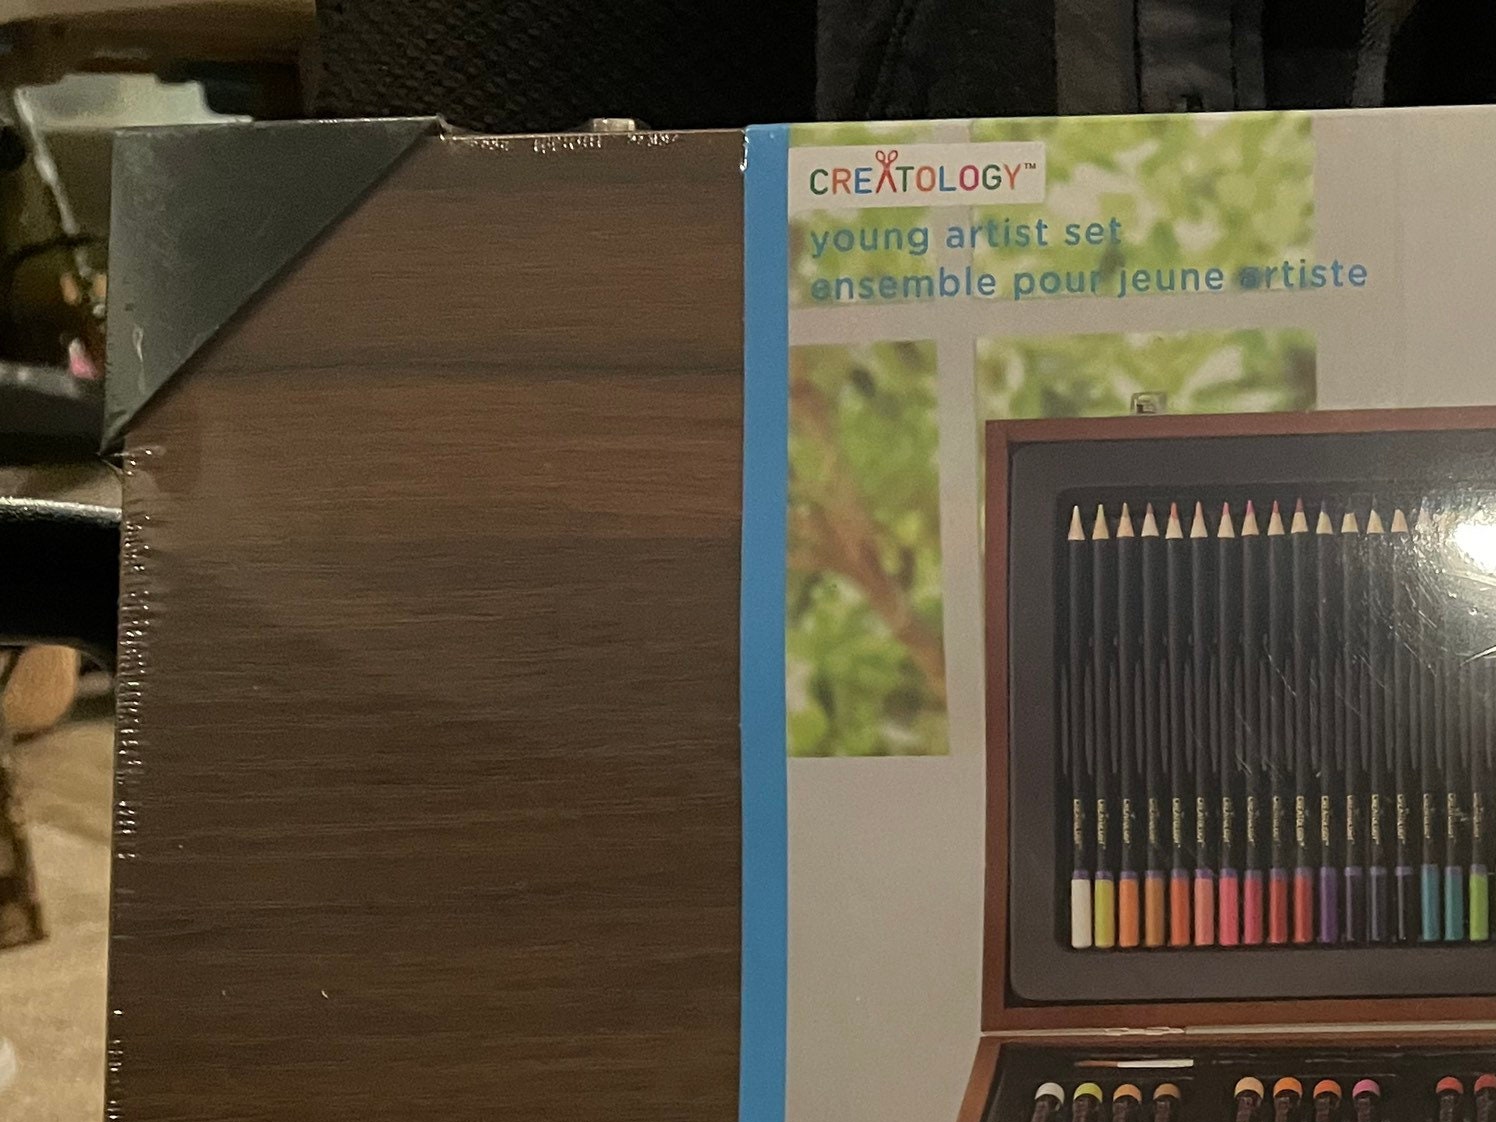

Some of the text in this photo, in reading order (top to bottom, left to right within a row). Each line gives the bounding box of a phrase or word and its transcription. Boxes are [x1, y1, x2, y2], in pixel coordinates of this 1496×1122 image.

[810, 217, 1121, 257] young artist set
[810, 258, 1367, 300] ensemble pour jeune artiste
